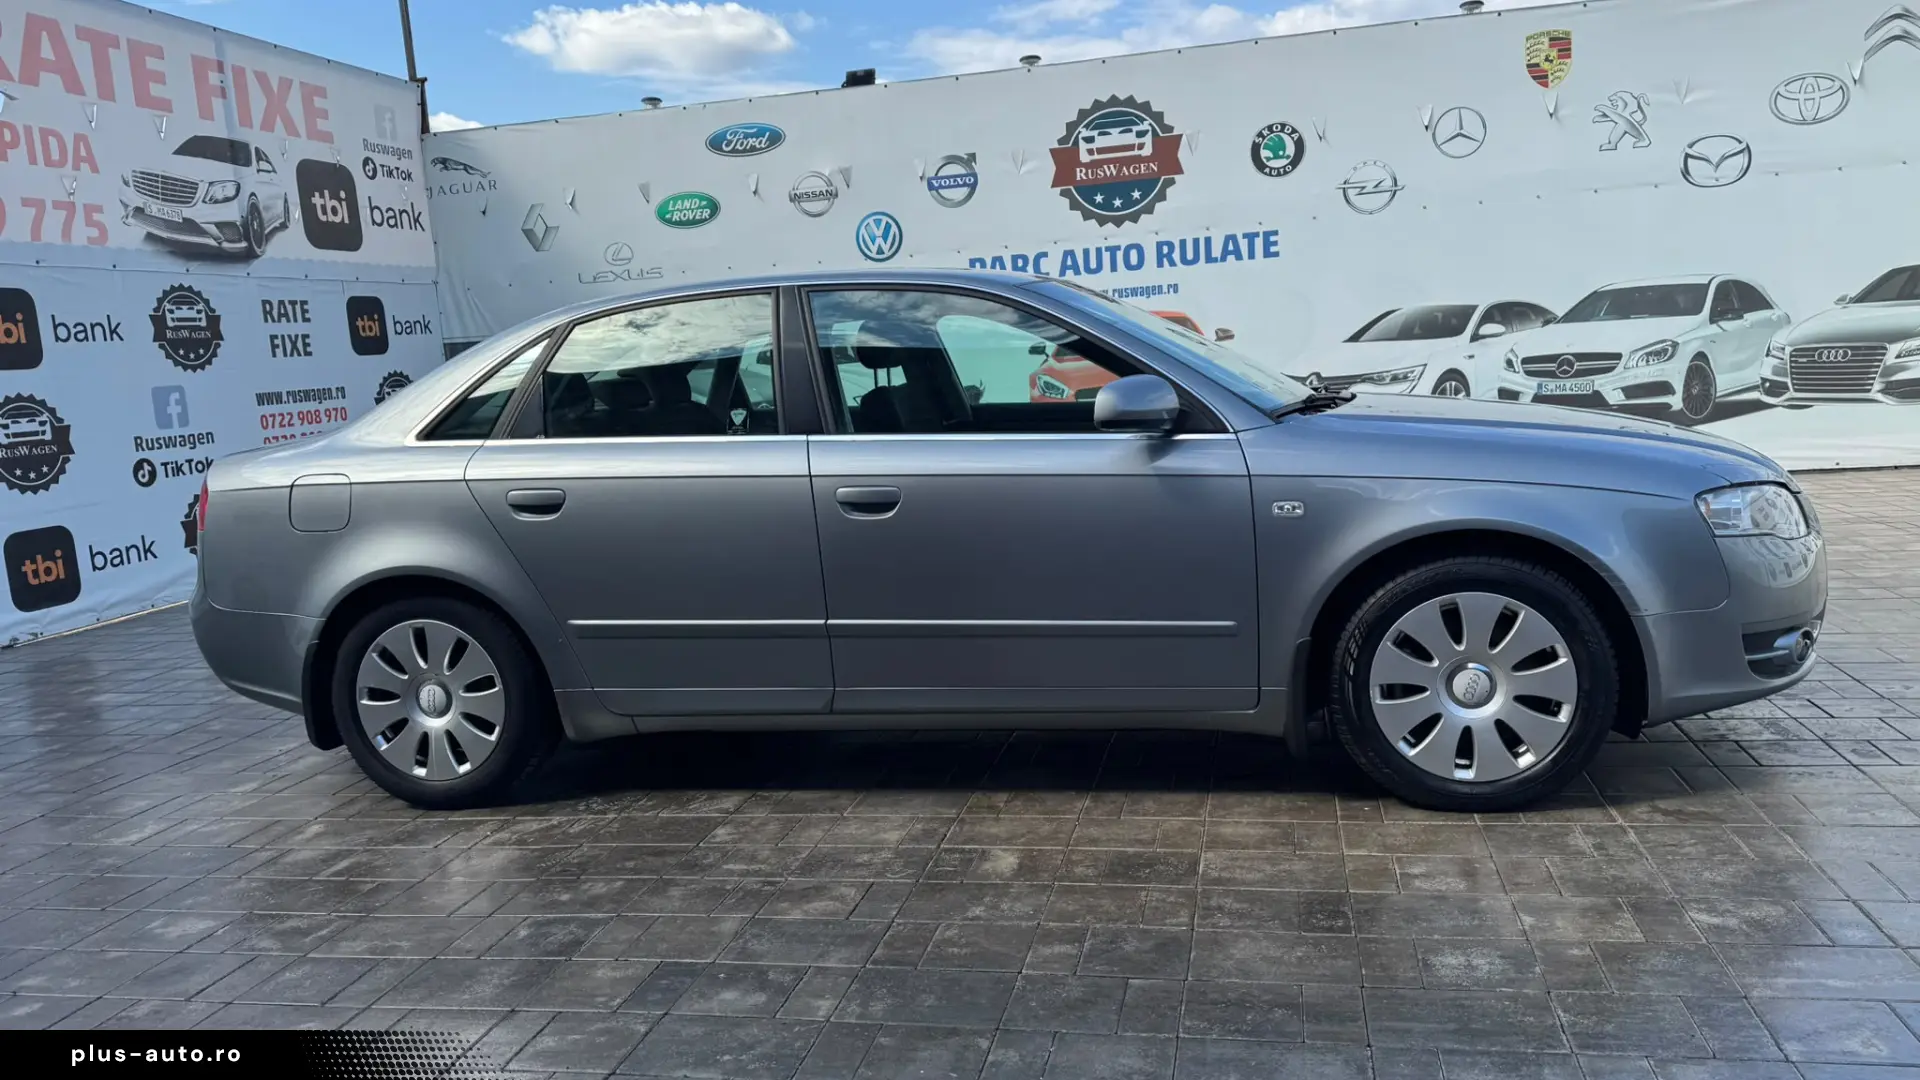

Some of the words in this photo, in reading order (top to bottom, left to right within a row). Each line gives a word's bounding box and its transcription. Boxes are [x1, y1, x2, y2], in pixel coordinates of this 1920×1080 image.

[1525, 29, 1571, 42] PORSCHE
[0, 12, 173, 113] ATE
[190, 53, 334, 144] FIXE
[0, 120, 100, 174] PIDA
[362, 138, 413, 160] Ruswagen
[722, 128, 770, 152] Ford
[379, 163, 415, 182] TikTok
[931, 176, 975, 187] VOLVO
[1263, 165, 1292, 176] AUTO
[426, 179, 498, 200] JAGUAR
[793, 188, 833, 200] NISSAN
[311, 188, 350, 225] tbi
[368, 196, 426, 232] bank
[668, 198, 700, 211] LAND
[672, 208, 711, 222] ROVER
[20, 197, 109, 247] 775
[1058, 242, 1145, 278] AUTO
[1156, 229, 1280, 269] RULATE
[1100, 283, 1179, 299] ruswagen.ro
[260, 299, 311, 323] RATE
[50, 314, 125, 343] bank
[355, 313, 380, 337] tbi
[392, 314, 433, 336] bank
[269, 333, 313, 358] FIXE
[255, 385, 346, 406] www.ruswagen.ro
[260, 411, 295, 430] 0722
[297, 409, 322, 426] 908
[324, 406, 348, 423] 970
[133, 431, 215, 452] Ruswagen
[21, 549, 65, 586] tbi
[89, 535, 159, 572] bank
